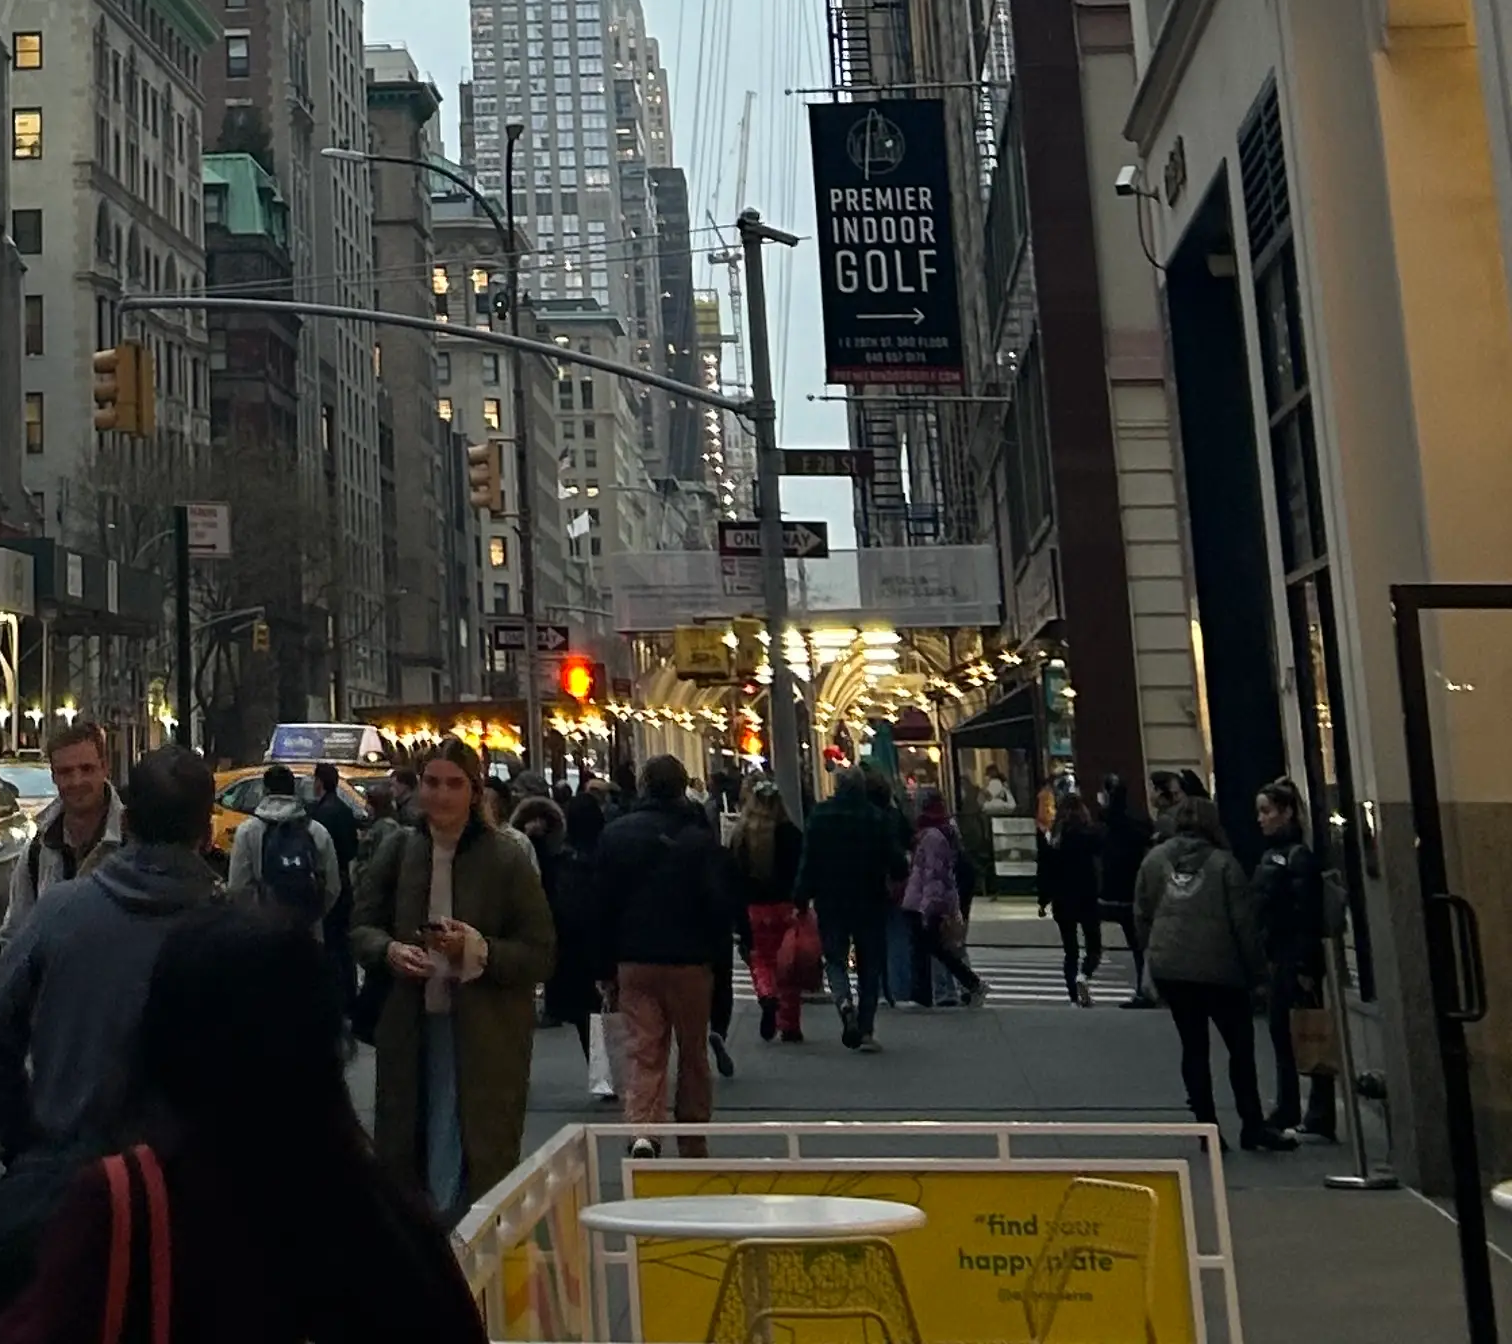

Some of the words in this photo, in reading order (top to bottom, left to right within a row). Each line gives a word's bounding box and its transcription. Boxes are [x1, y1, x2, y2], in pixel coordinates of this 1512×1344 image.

[829, 186, 934, 212] PREMIER
[832, 215, 936, 244] INDOOR
[835, 249, 937, 293] GOLF
[801, 455, 810, 473] E
